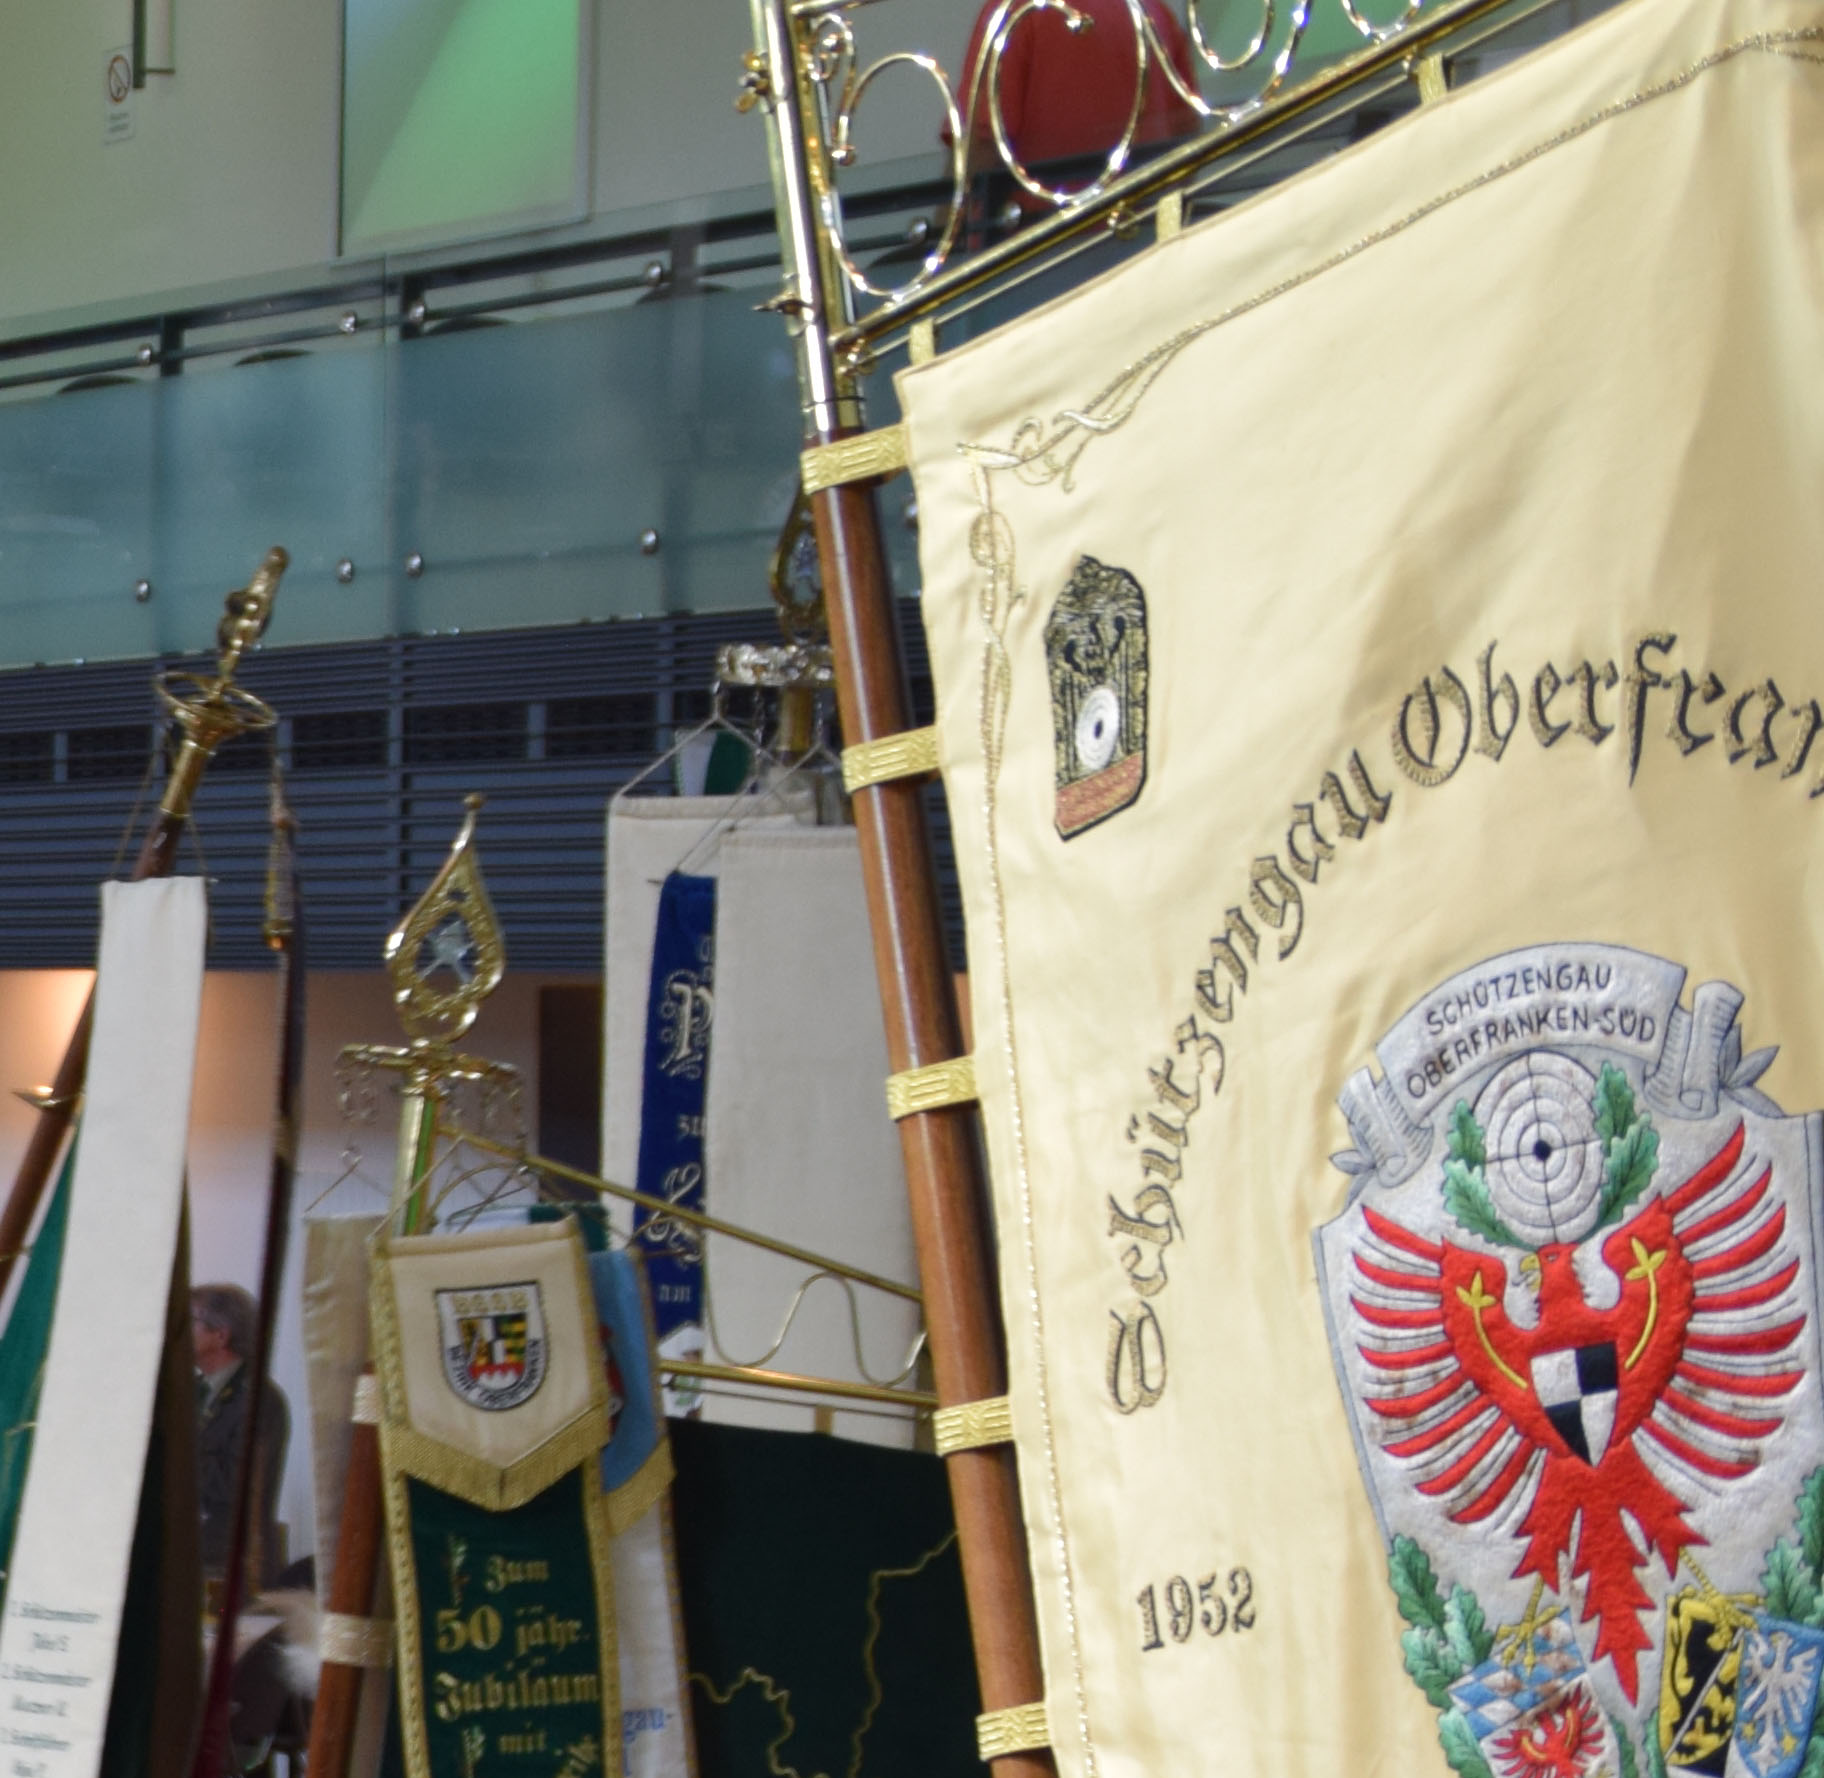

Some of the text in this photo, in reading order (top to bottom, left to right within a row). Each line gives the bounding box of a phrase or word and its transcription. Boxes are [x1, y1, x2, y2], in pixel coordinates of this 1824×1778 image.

[1426, 963, 1613, 1037] SCHÜTZENGAU
[1105, 748, 1392, 1414] Schützengau
[1406, 1004, 1657, 1100] OBERFRANKEN-SÜD
[435, 1603, 503, 1654] 50
[1136, 1564, 1258, 1652] 1952
[498, 1721, 547, 1754] mit
